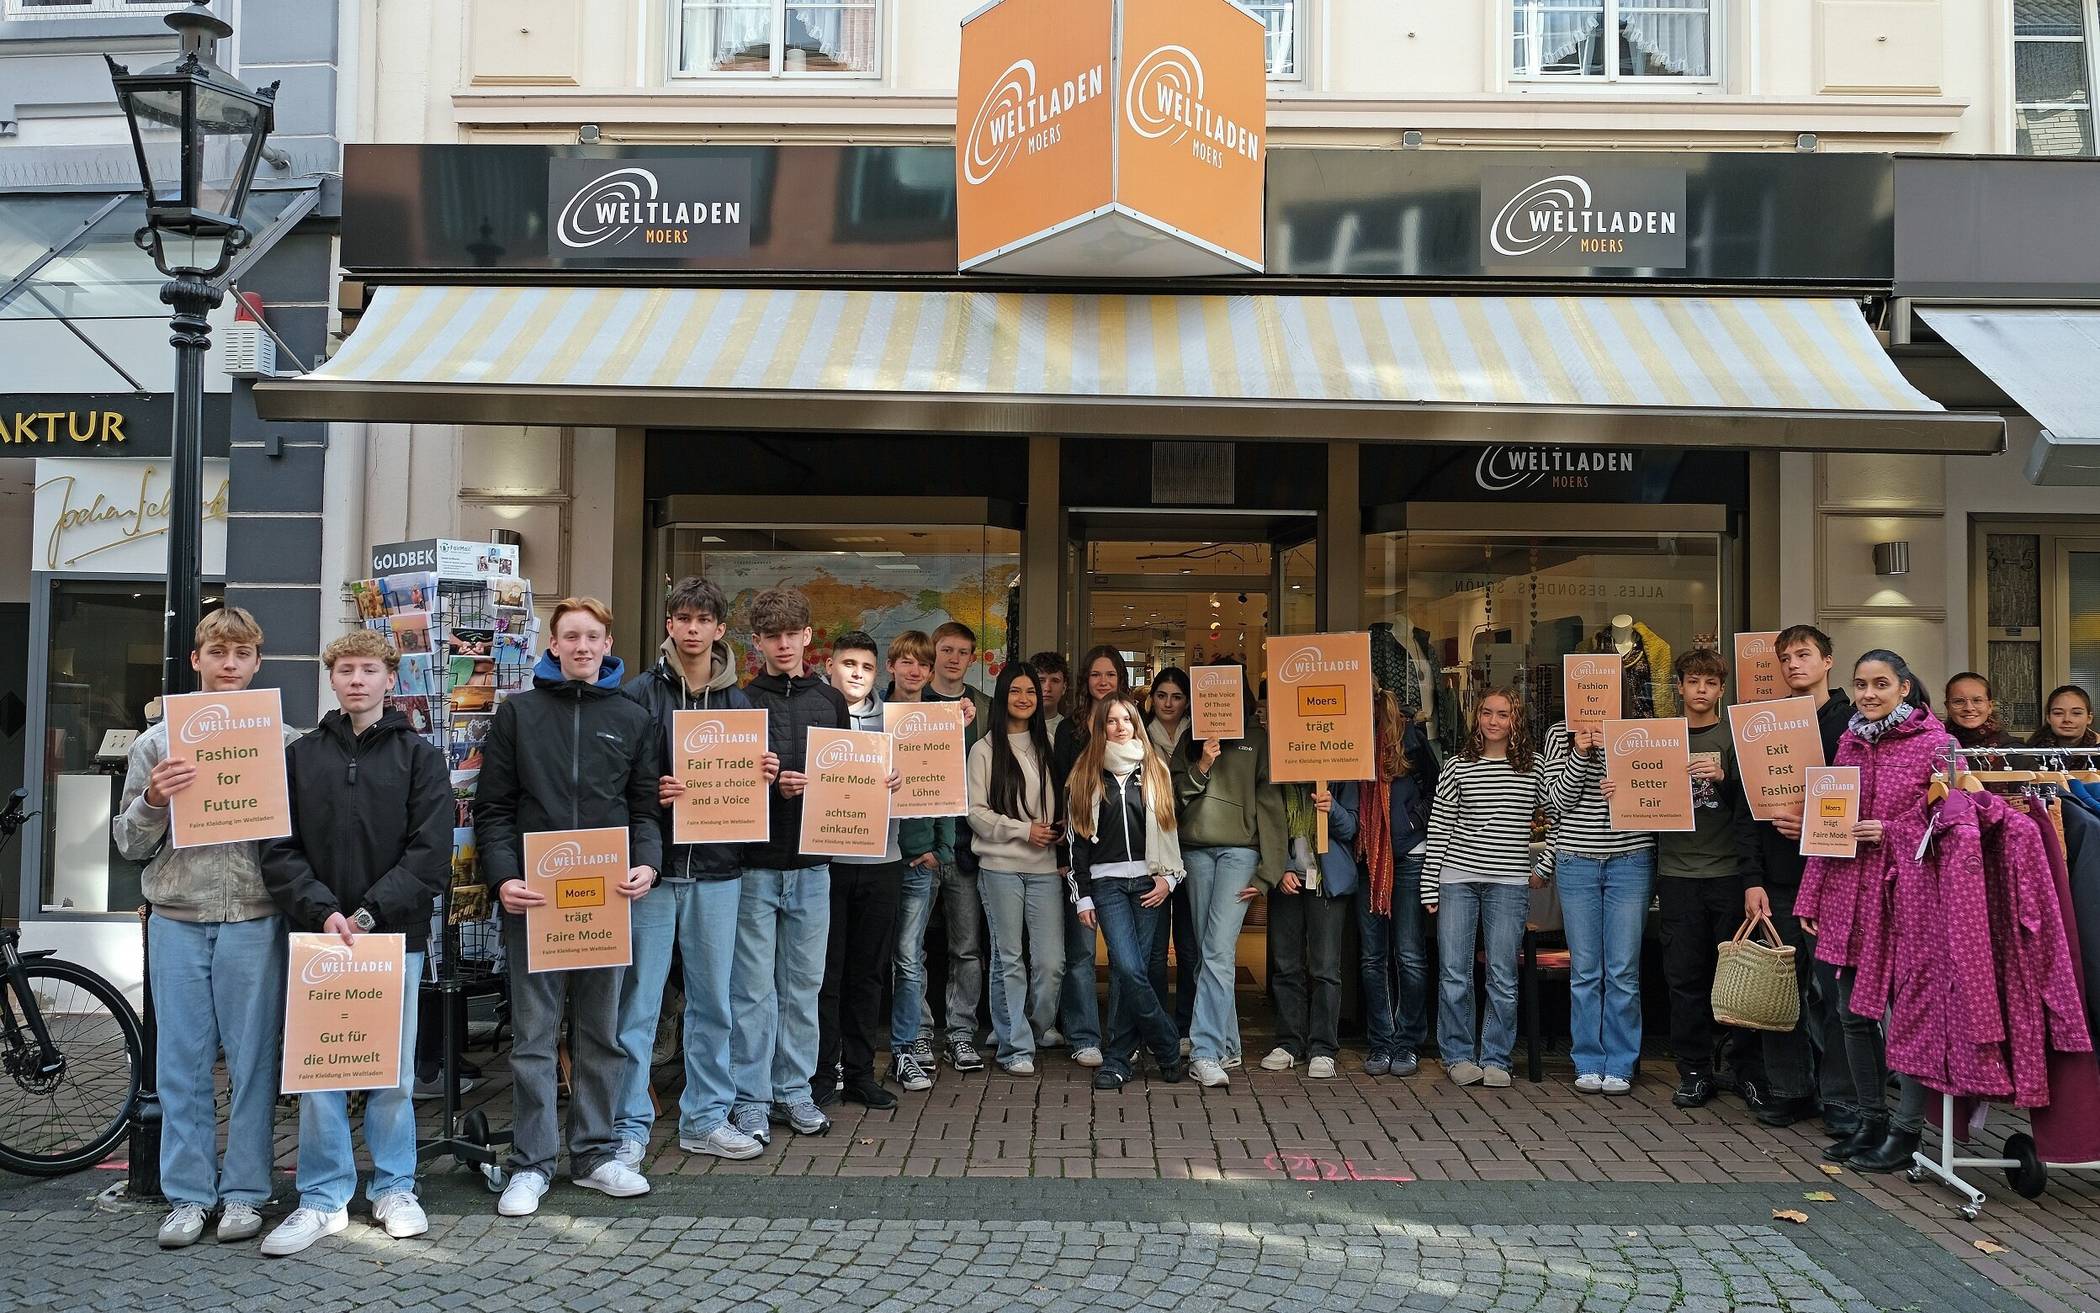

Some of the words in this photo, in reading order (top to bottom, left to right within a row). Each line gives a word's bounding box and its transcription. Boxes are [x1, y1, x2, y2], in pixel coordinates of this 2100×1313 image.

[990, 65, 1103, 146] WELTLADEN
[1157, 82, 1259, 162] WELTLADEN
[1028, 124, 1061, 155] MOERS
[1192, 139, 1223, 168] MOERS
[596, 203, 740, 224] WELTLADEN
[1529, 210, 1676, 234] WELTLADEN
[646, 229, 688, 244] MOERS
[1581, 239, 1623, 253] MOERS
[1508, 451, 1633, 471] WELTLADEN
[1552, 476, 1588, 488] MOERS
[374, 549, 435, 570] GOLDBEK
[1296, 660, 1359, 673] WELTLADEN
[1307, 696, 1337, 705] Moers
[199, 717, 271, 732] WELTLADEN
[905, 721, 955, 732] WELTLADEN
[1306, 722, 1334, 733] trägt
[1754, 720, 1809, 734] WELTLADEN
[699, 733, 758, 744] WELTLADEN
[1626, 739, 1680, 748] WELTLADEN
[899, 743, 921, 751] Faire
[924, 743, 950, 751] Mode
[1288, 741, 1317, 751] Faire
[1320, 740, 1354, 750] Mode
[1766, 744, 1789, 755] Exit
[196, 746, 258, 762] Fashion
[830, 752, 882, 764] WELTLADEN
[688, 758, 712, 770] Fair
[716, 758, 754, 769] Trade
[1632, 760, 1663, 769] Good
[1768, 764, 1794, 775] Fast
[217, 772, 240, 785] for
[686, 779, 713, 788] Gives
[724, 778, 756, 787] choice
[820, 773, 844, 784] Faire
[848, 775, 876, 785] Mode
[905, 774, 945, 784] gerechte
[1631, 779, 1667, 788] Better
[912, 788, 940, 797] Löhne
[204, 798, 258, 812] Future
[692, 796, 710, 806] and
[723, 795, 750, 804] Voice
[1640, 798, 1661, 807] Fair
[825, 808, 866, 819] achtsam
[820, 824, 869, 835] einkaufen
[554, 854, 618, 867] WELTLADEN
[566, 889, 596, 898] Moers
[565, 912, 593, 924] trägt
[546, 932, 575, 942] Faire
[579, 929, 612, 940] Mode
[322, 962, 392, 973] WELTLADEN
[309, 990, 340, 1000] Faire
[345, 988, 383, 999] Mode
[320, 1032, 344, 1043] Gut
[348, 1031, 367, 1042] für
[304, 1054, 324, 1065] die
[328, 1052, 380, 1065] Umwelt
